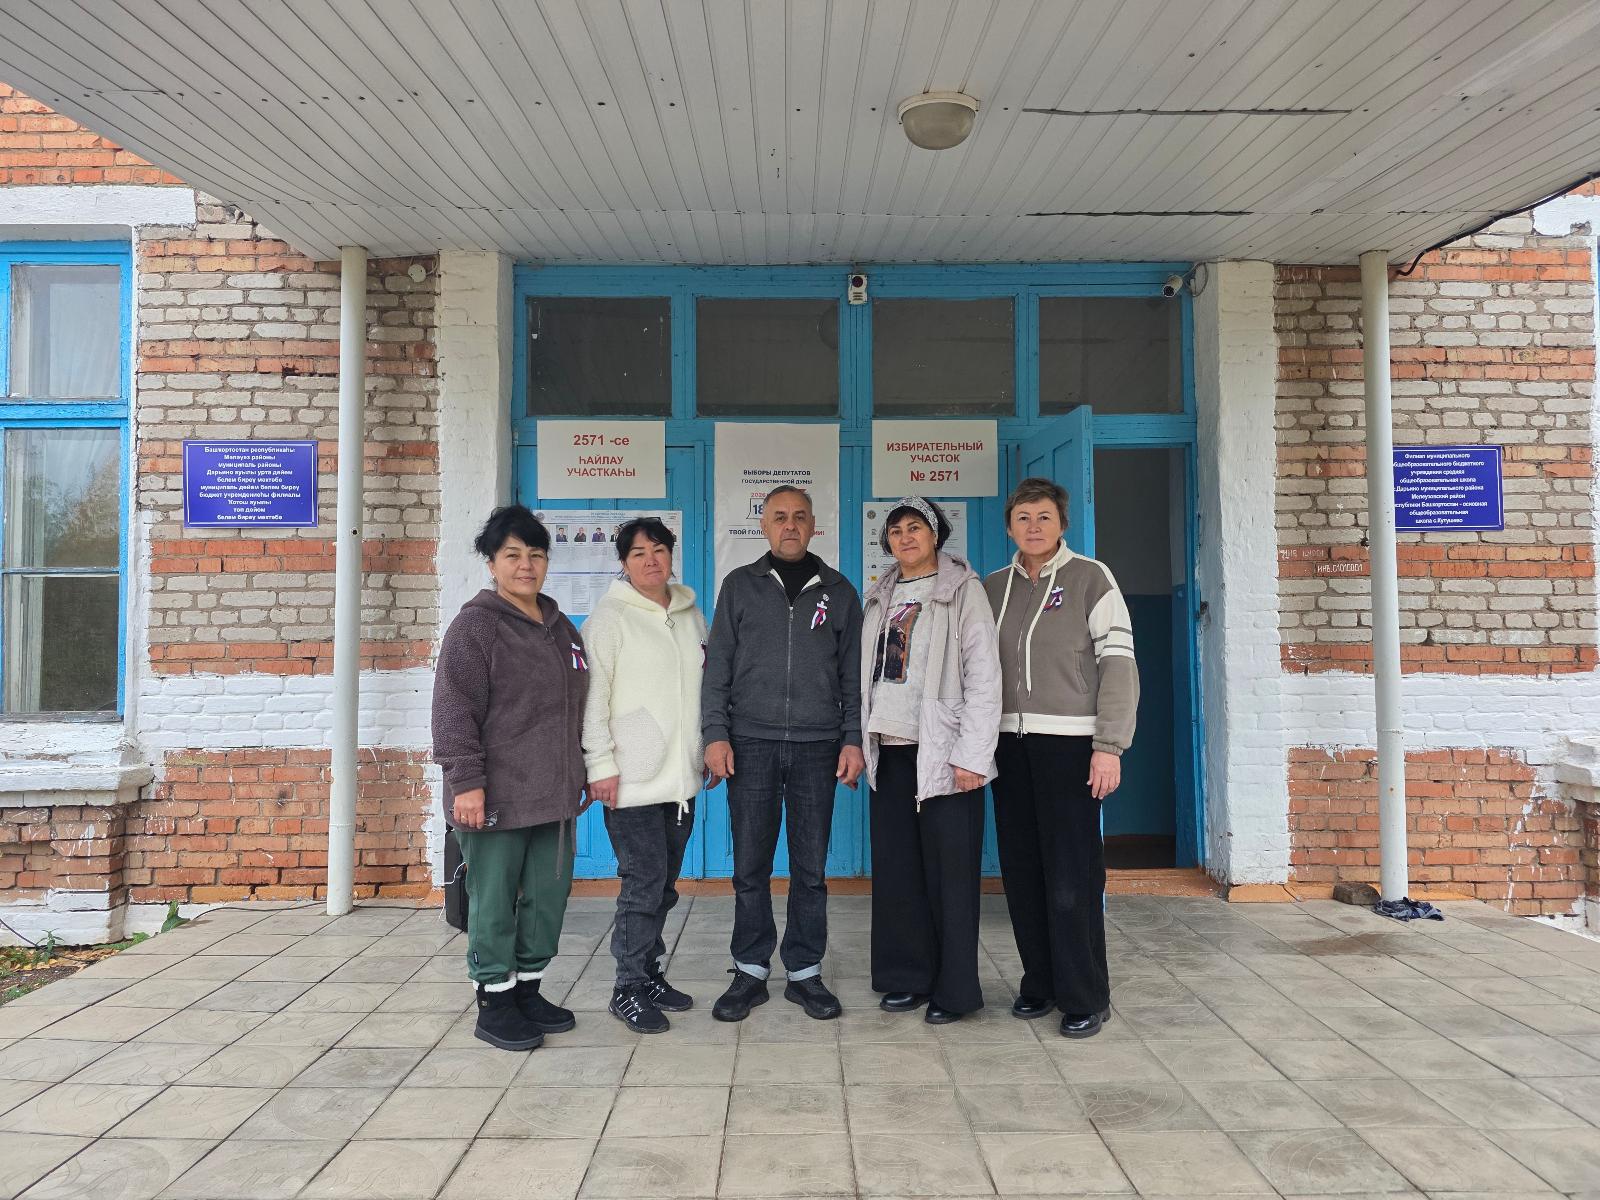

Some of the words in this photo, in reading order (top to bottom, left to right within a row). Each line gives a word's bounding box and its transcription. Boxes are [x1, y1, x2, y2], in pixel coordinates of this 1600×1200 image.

[574, 434, 604, 446] 2571
[887, 441, 983, 452] ИЗБИРАТЕЛЬНЫЙ
[911, 454, 960, 463] УЧАСТОК
[910, 471, 925, 481] №
[930, 470, 959, 481] 2571
